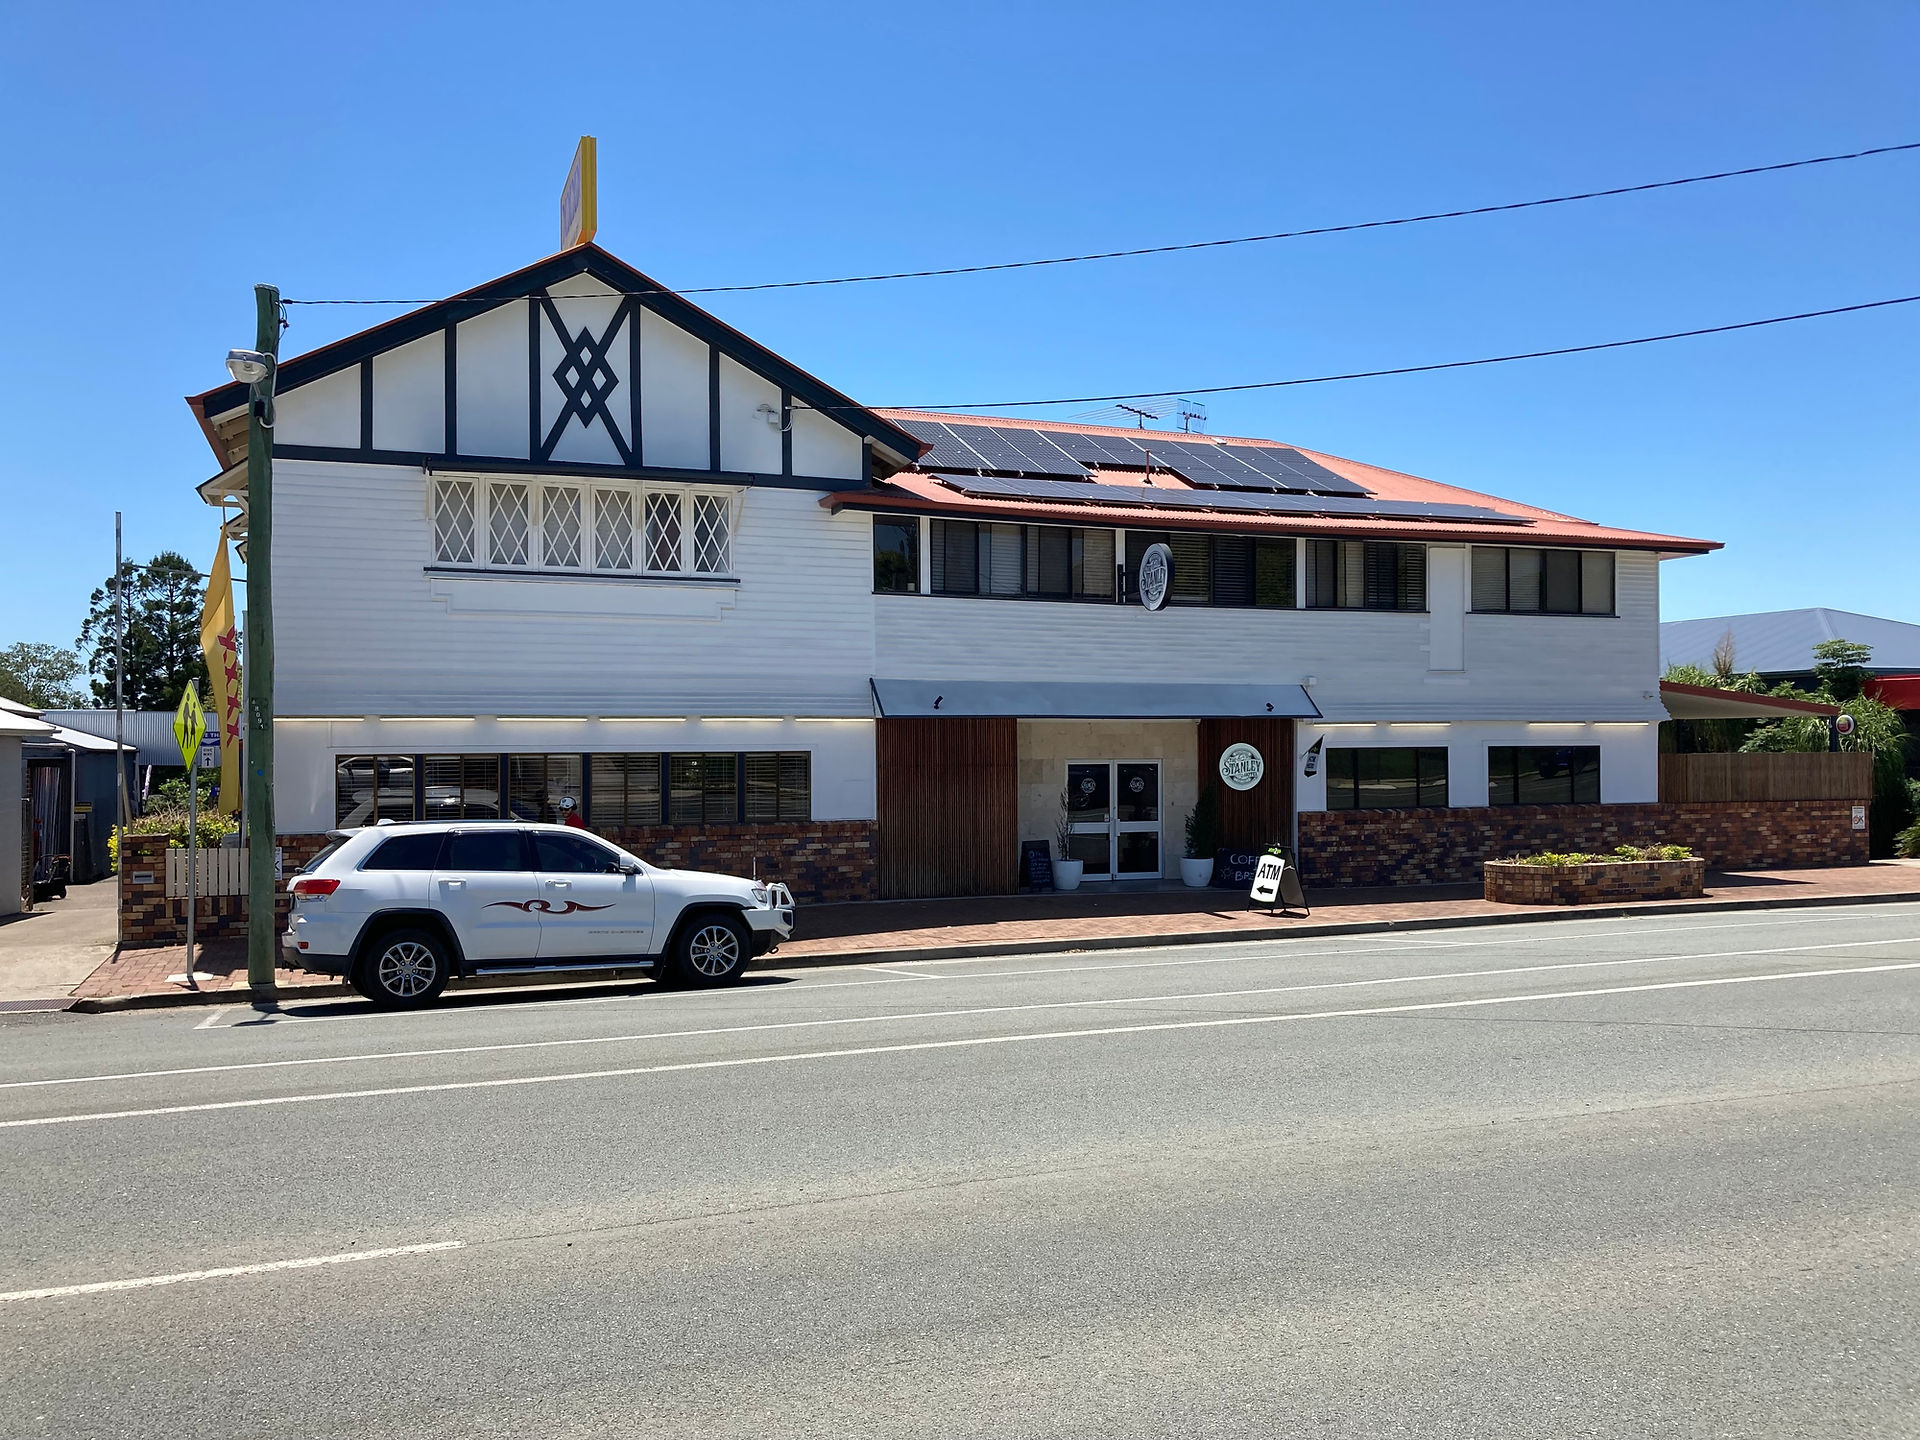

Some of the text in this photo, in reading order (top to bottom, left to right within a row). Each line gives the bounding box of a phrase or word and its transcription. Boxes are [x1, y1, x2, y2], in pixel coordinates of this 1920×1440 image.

[1222, 760, 1261, 777] STANLEY
[1230, 854, 1260, 865] COFF
[1257, 863, 1282, 881] ATM
